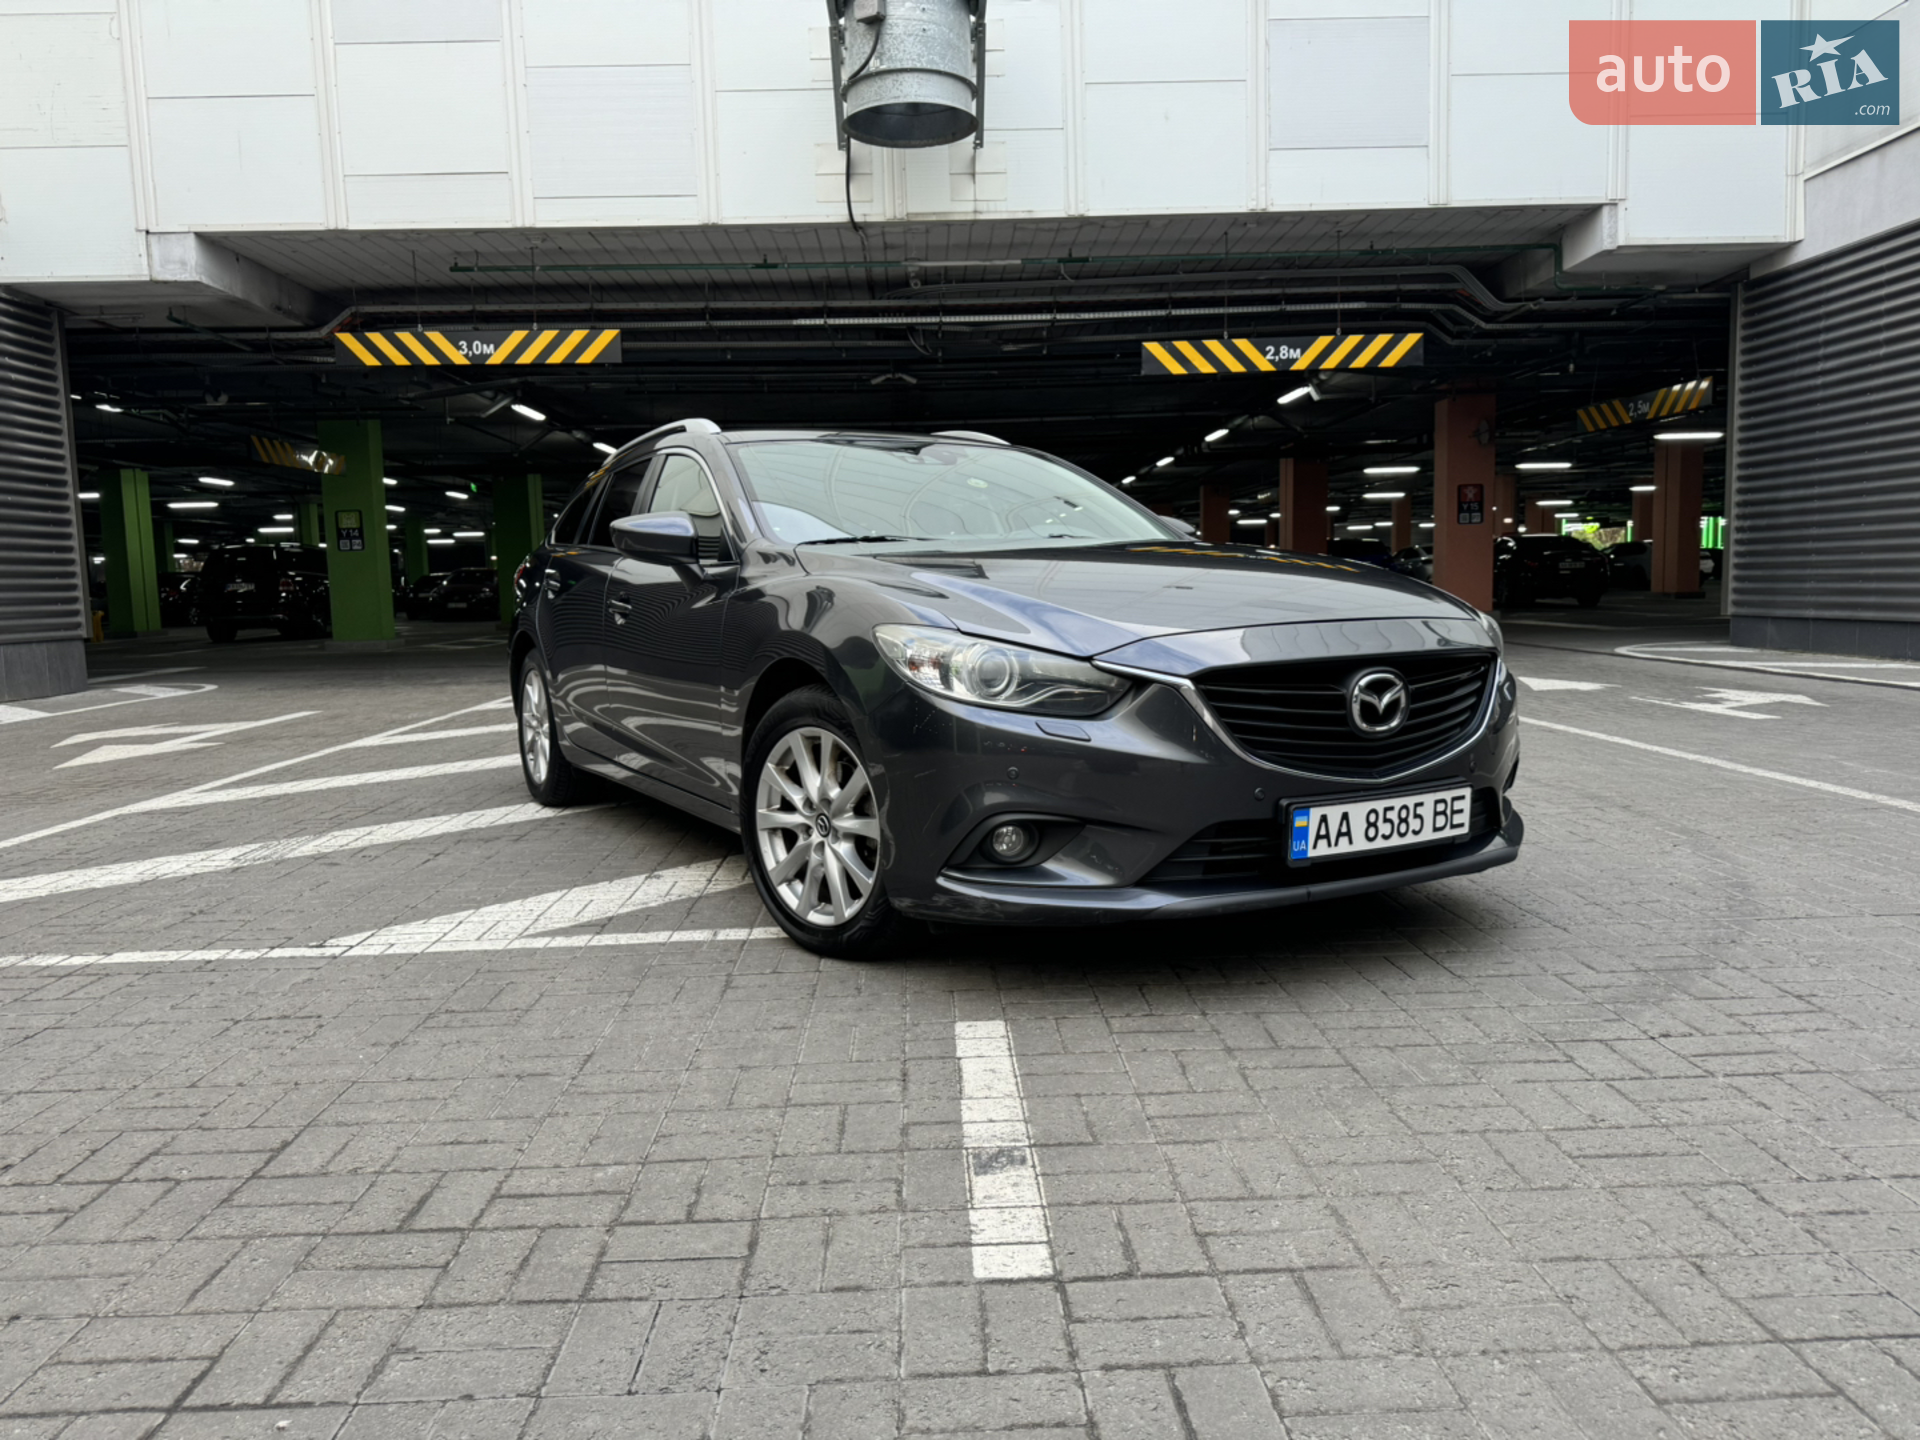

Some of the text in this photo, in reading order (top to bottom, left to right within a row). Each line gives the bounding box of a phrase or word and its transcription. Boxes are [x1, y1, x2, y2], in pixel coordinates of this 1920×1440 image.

[1312, 795, 1466, 850] AA 8585 BE
[1293, 840, 1307, 851] UA
